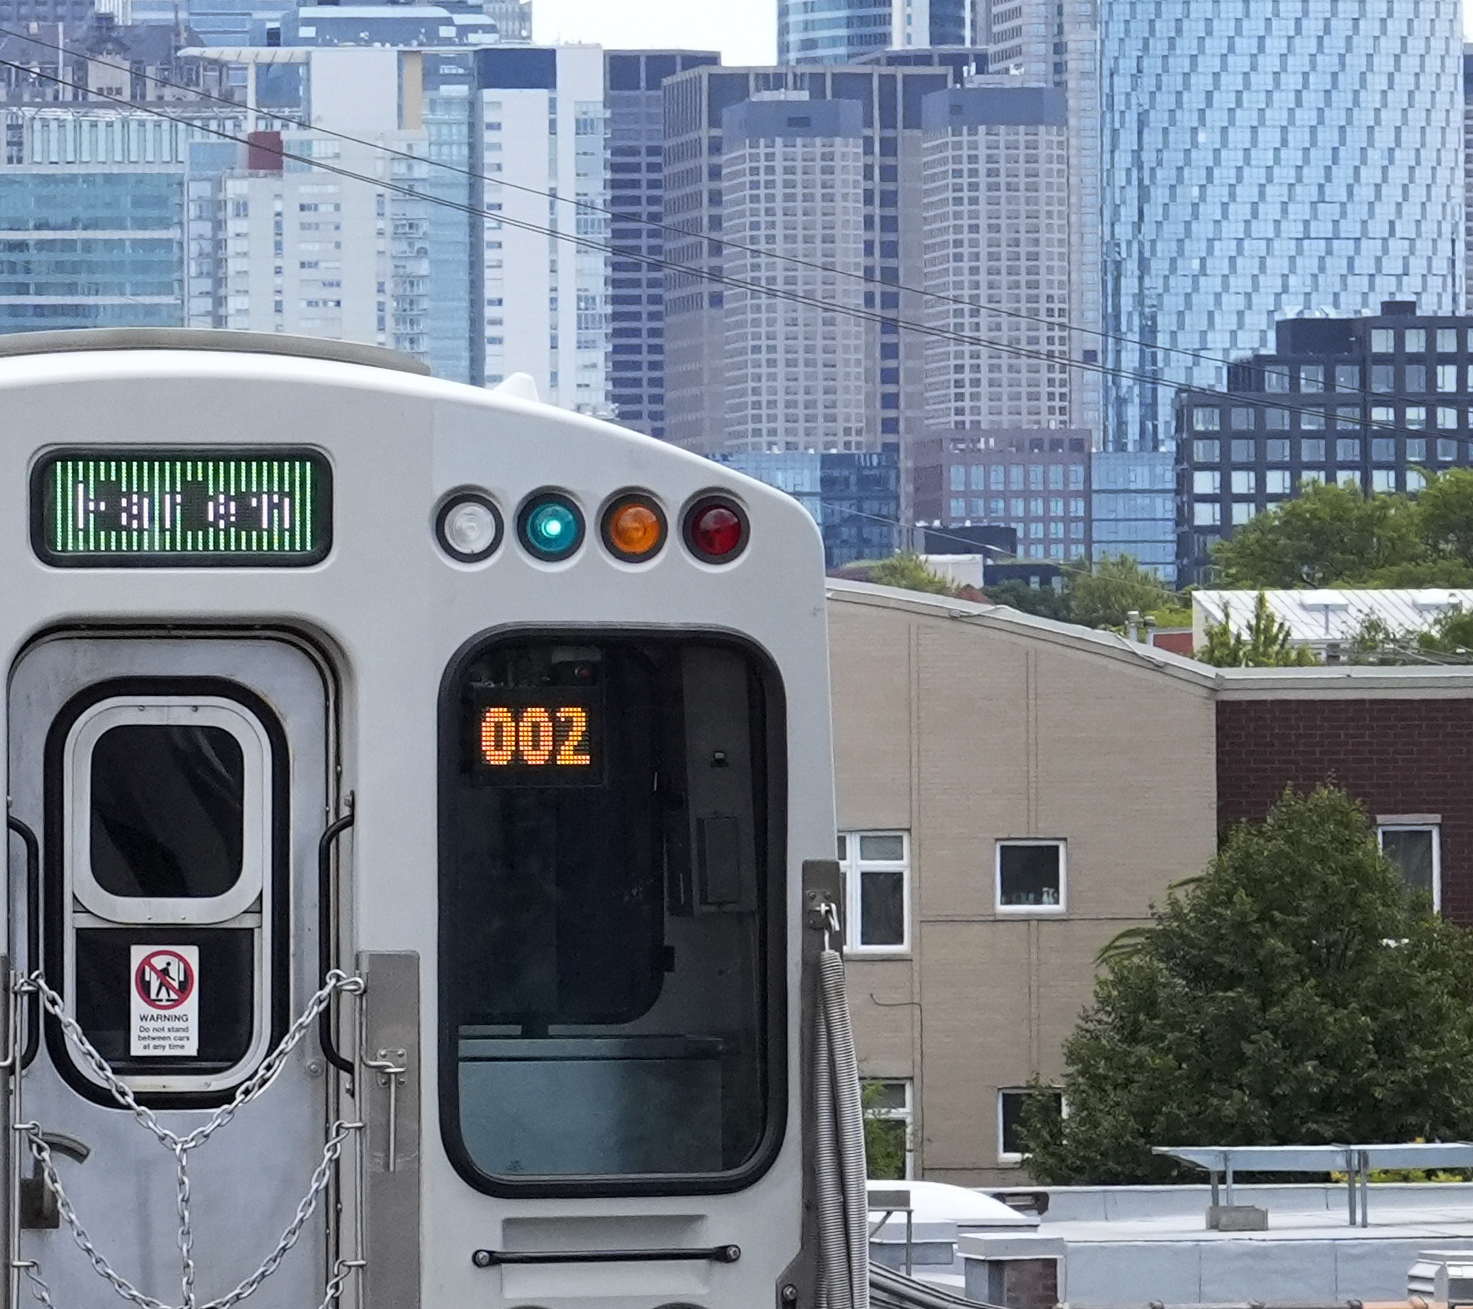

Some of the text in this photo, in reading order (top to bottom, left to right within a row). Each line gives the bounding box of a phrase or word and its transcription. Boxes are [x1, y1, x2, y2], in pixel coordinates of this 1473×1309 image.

[481, 706, 591, 766] 002
[139, 1013, 189, 1023] WARNING
[138, 1025, 151, 1033] Do
[167, 1025, 190, 1033] stand
[137, 1034, 172, 1042] between
[142, 1043, 151, 1051] at
[168, 1043, 186, 1051] time
